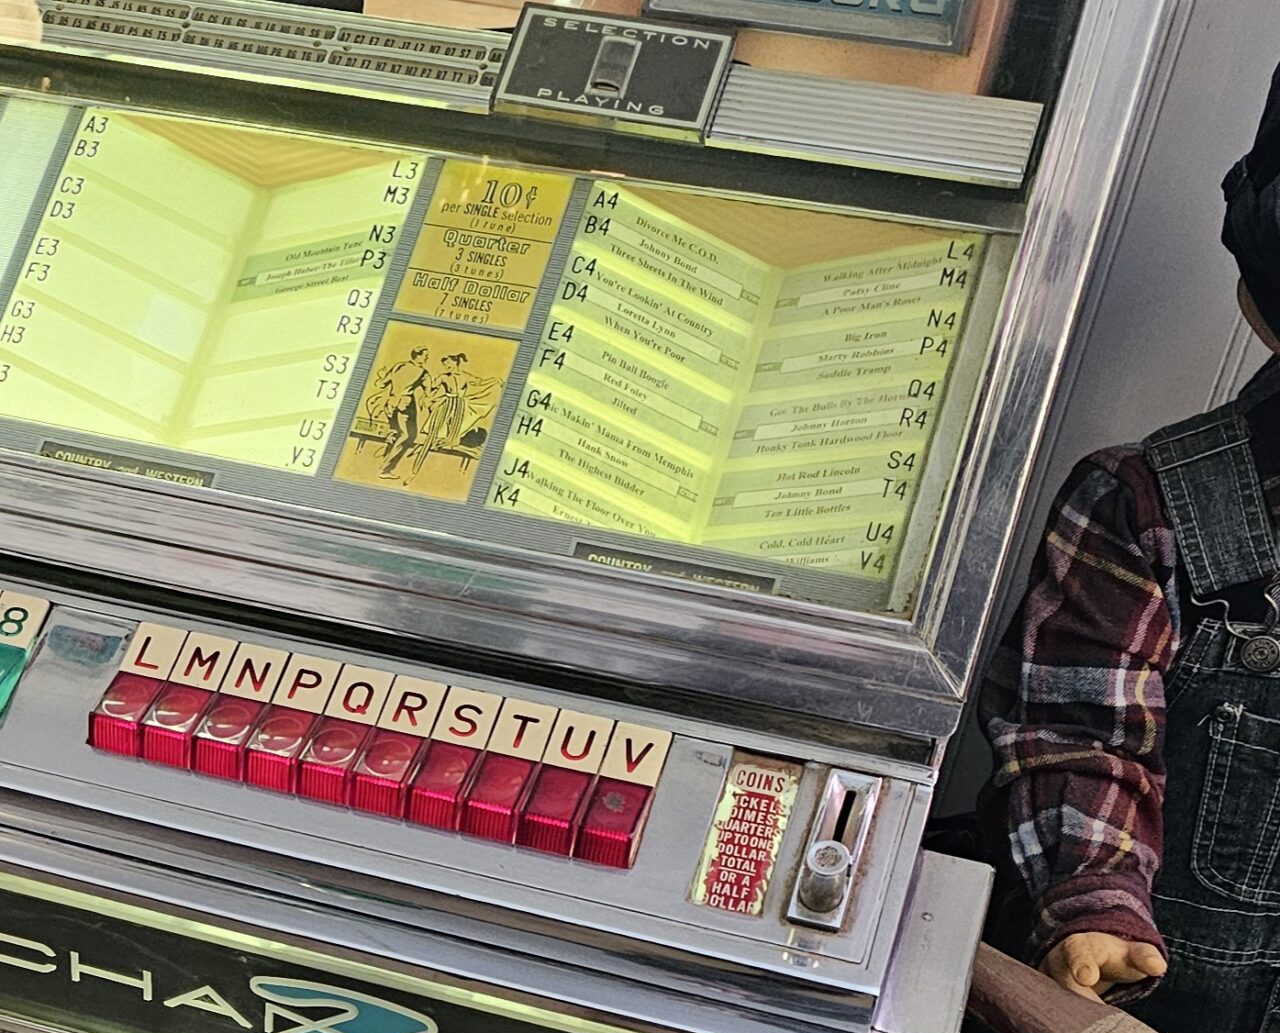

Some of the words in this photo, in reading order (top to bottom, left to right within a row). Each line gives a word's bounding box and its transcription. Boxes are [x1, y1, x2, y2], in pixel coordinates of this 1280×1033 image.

[543, 17, 711, 50] SELECTION
[537, 88, 665, 116] PLAYING
[74, 140, 99, 158] B3
[383, 186, 409, 205] M3
[481, 180, 538, 209] 10¢
[593, 190, 619, 210] A4
[441, 202, 462, 213] per
[464, 203, 500, 218] SINGLE
[501, 211, 552, 226] selection
[584, 216, 611, 236] B4
[443, 229, 531, 255] Quarter
[636, 216, 671, 240] Divorce
[688, 243, 719, 264] C.O.D.
[360, 249, 387, 270] P3
[455, 247, 464, 261] 3
[467, 251, 508, 268] SINGLES
[639, 239, 671, 261] Johnny
[673, 257, 698, 274] Bond
[610, 244, 636, 262] Three
[637, 258, 665, 277] Sheets
[667, 273, 678, 284] In
[679, 278, 697, 293] The
[699, 288, 723, 306] Wind
[413, 272, 459, 291] Half
[463, 280, 530, 303] Dollar
[562, 282, 588, 302] D4
[440, 293, 448, 305] 7
[452, 296, 493, 313] SINGLES
[596, 271, 625, 293] You're
[627, 288, 663, 310] Lookin'
[664, 307, 675, 317] At
[677, 313, 714, 337] Country
[617, 303, 650, 326] Loretta
[652, 321, 676, 338] Lynn
[927, 309, 957, 330] N4
[604, 316, 630, 335] When
[633, 330, 662, 351] You're
[664, 346, 686, 363] Poor
[539, 349, 567, 370] F4
[601, 351, 617, 364] Pin
[619, 359, 637, 375] Ball
[639, 369, 670, 390] Boogie
[603, 373, 621, 387] Red
[611, 397, 638, 416] Jilted
[562, 407, 594, 429] Makin'
[597, 425, 624, 445] Mama
[626, 440, 651, 458] From
[653, 452, 694, 479] Memphis
[577, 438, 602, 456] Hank
[605, 451, 628, 468] Snow
[559, 449, 576, 463] The
[578, 458, 612, 481] Highest
[614, 475, 645, 497] Bidder
[822, 467, 861, 477] Lincoln
[493, 484, 520, 507] K4
[882, 478, 908, 500] T4
[567, 491, 583, 504] The
[586, 499, 610, 517] Floor
[613, 512, 635, 528] Over
[134, 636, 160, 670] L
[183, 646, 220, 683] M
[234, 657, 272, 693] N
[290, 668, 322, 699] P
[342, 682, 374, 716] Q
[393, 691, 428, 728] R
[449, 704, 483, 738] S
[511, 714, 540, 749] T
[561, 725, 597, 760] U
[624, 738, 654, 773] V
[737, 770, 785, 792] COINS
[718, 842, 766, 861] DOLLAR
[734, 833, 748, 845] TO
[750, 836, 774, 849] ONE
[721, 855, 757, 873] TOTAL
[720, 871, 736, 883] OR
[742, 876, 750, 886] A
[711, 882, 750, 898] HALF
